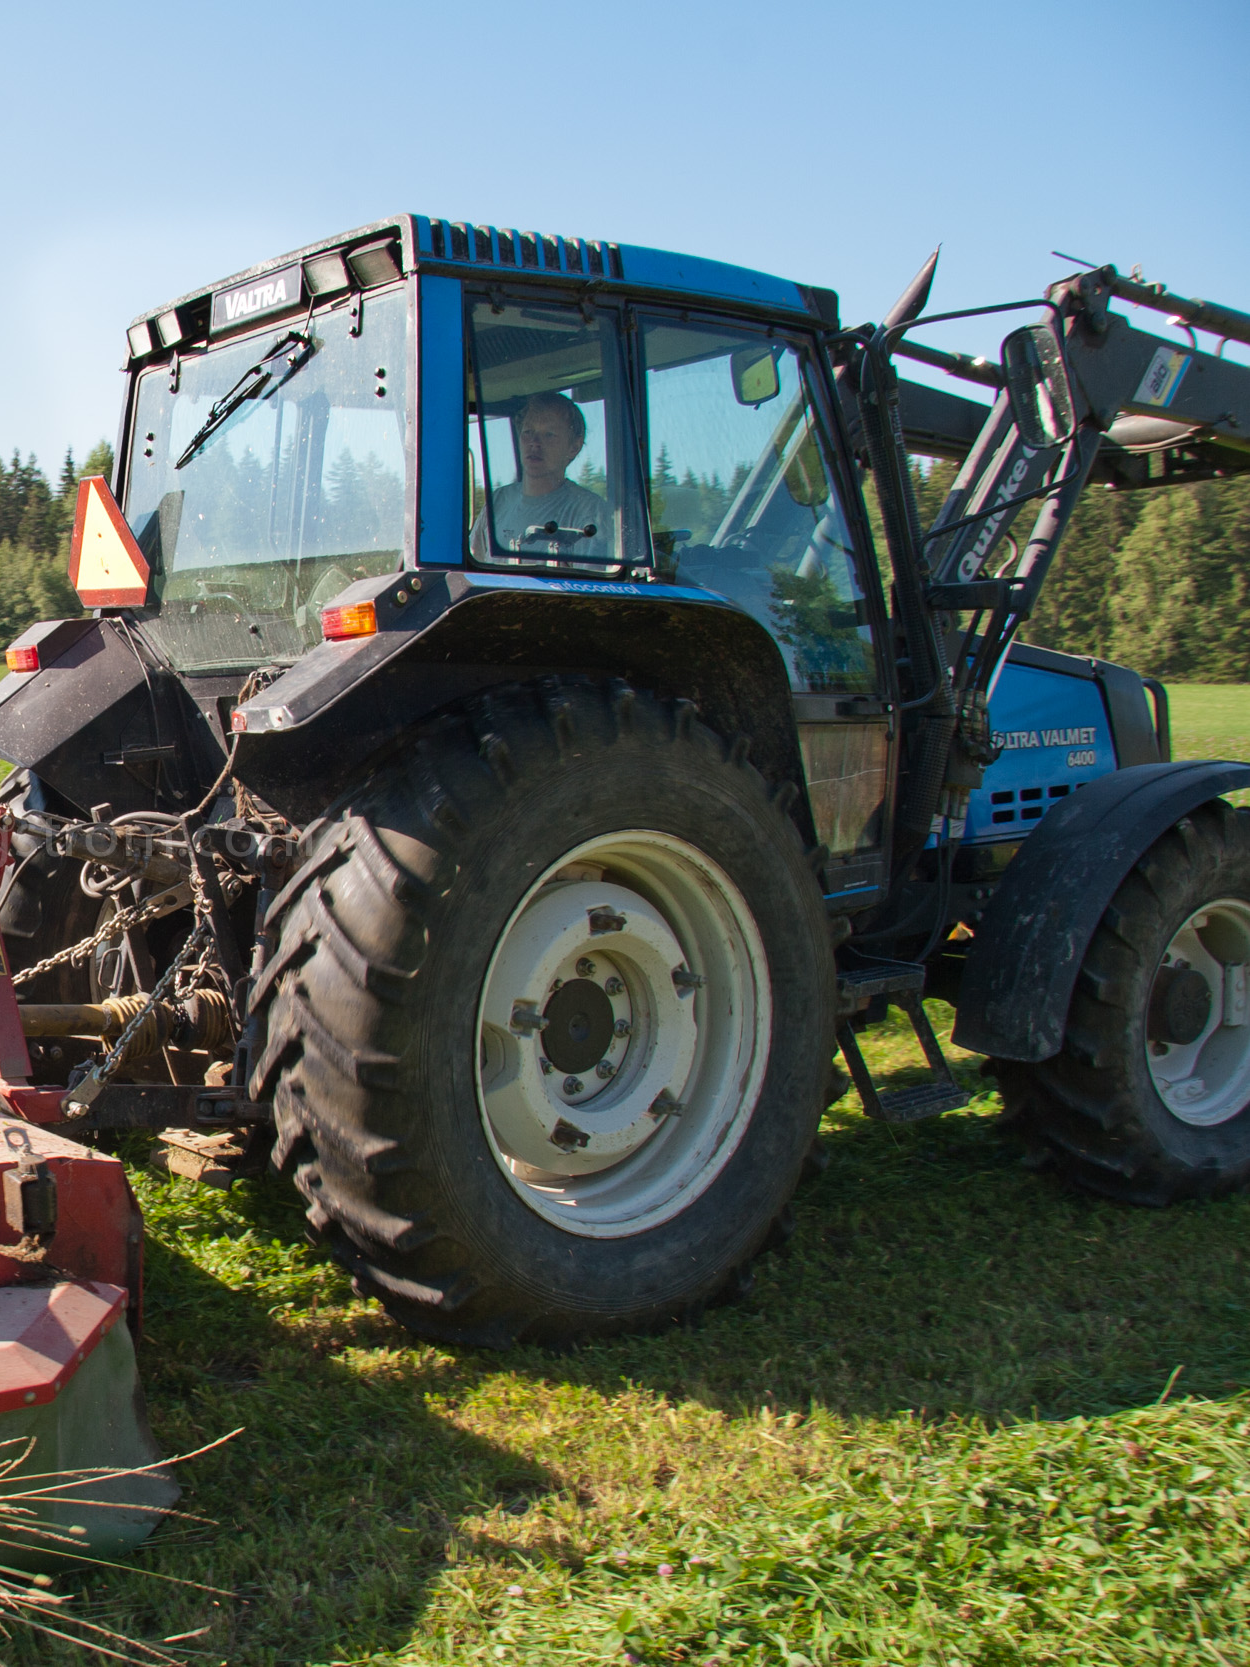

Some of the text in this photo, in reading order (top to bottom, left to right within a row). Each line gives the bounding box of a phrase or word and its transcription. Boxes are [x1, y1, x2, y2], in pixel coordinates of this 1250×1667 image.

[225, 279, 287, 320] VALTRA
[548, 580, 642, 595] autocontrol
[1040, 727, 1096, 747] VALMET
[1067, 750, 1095, 767] 6400
